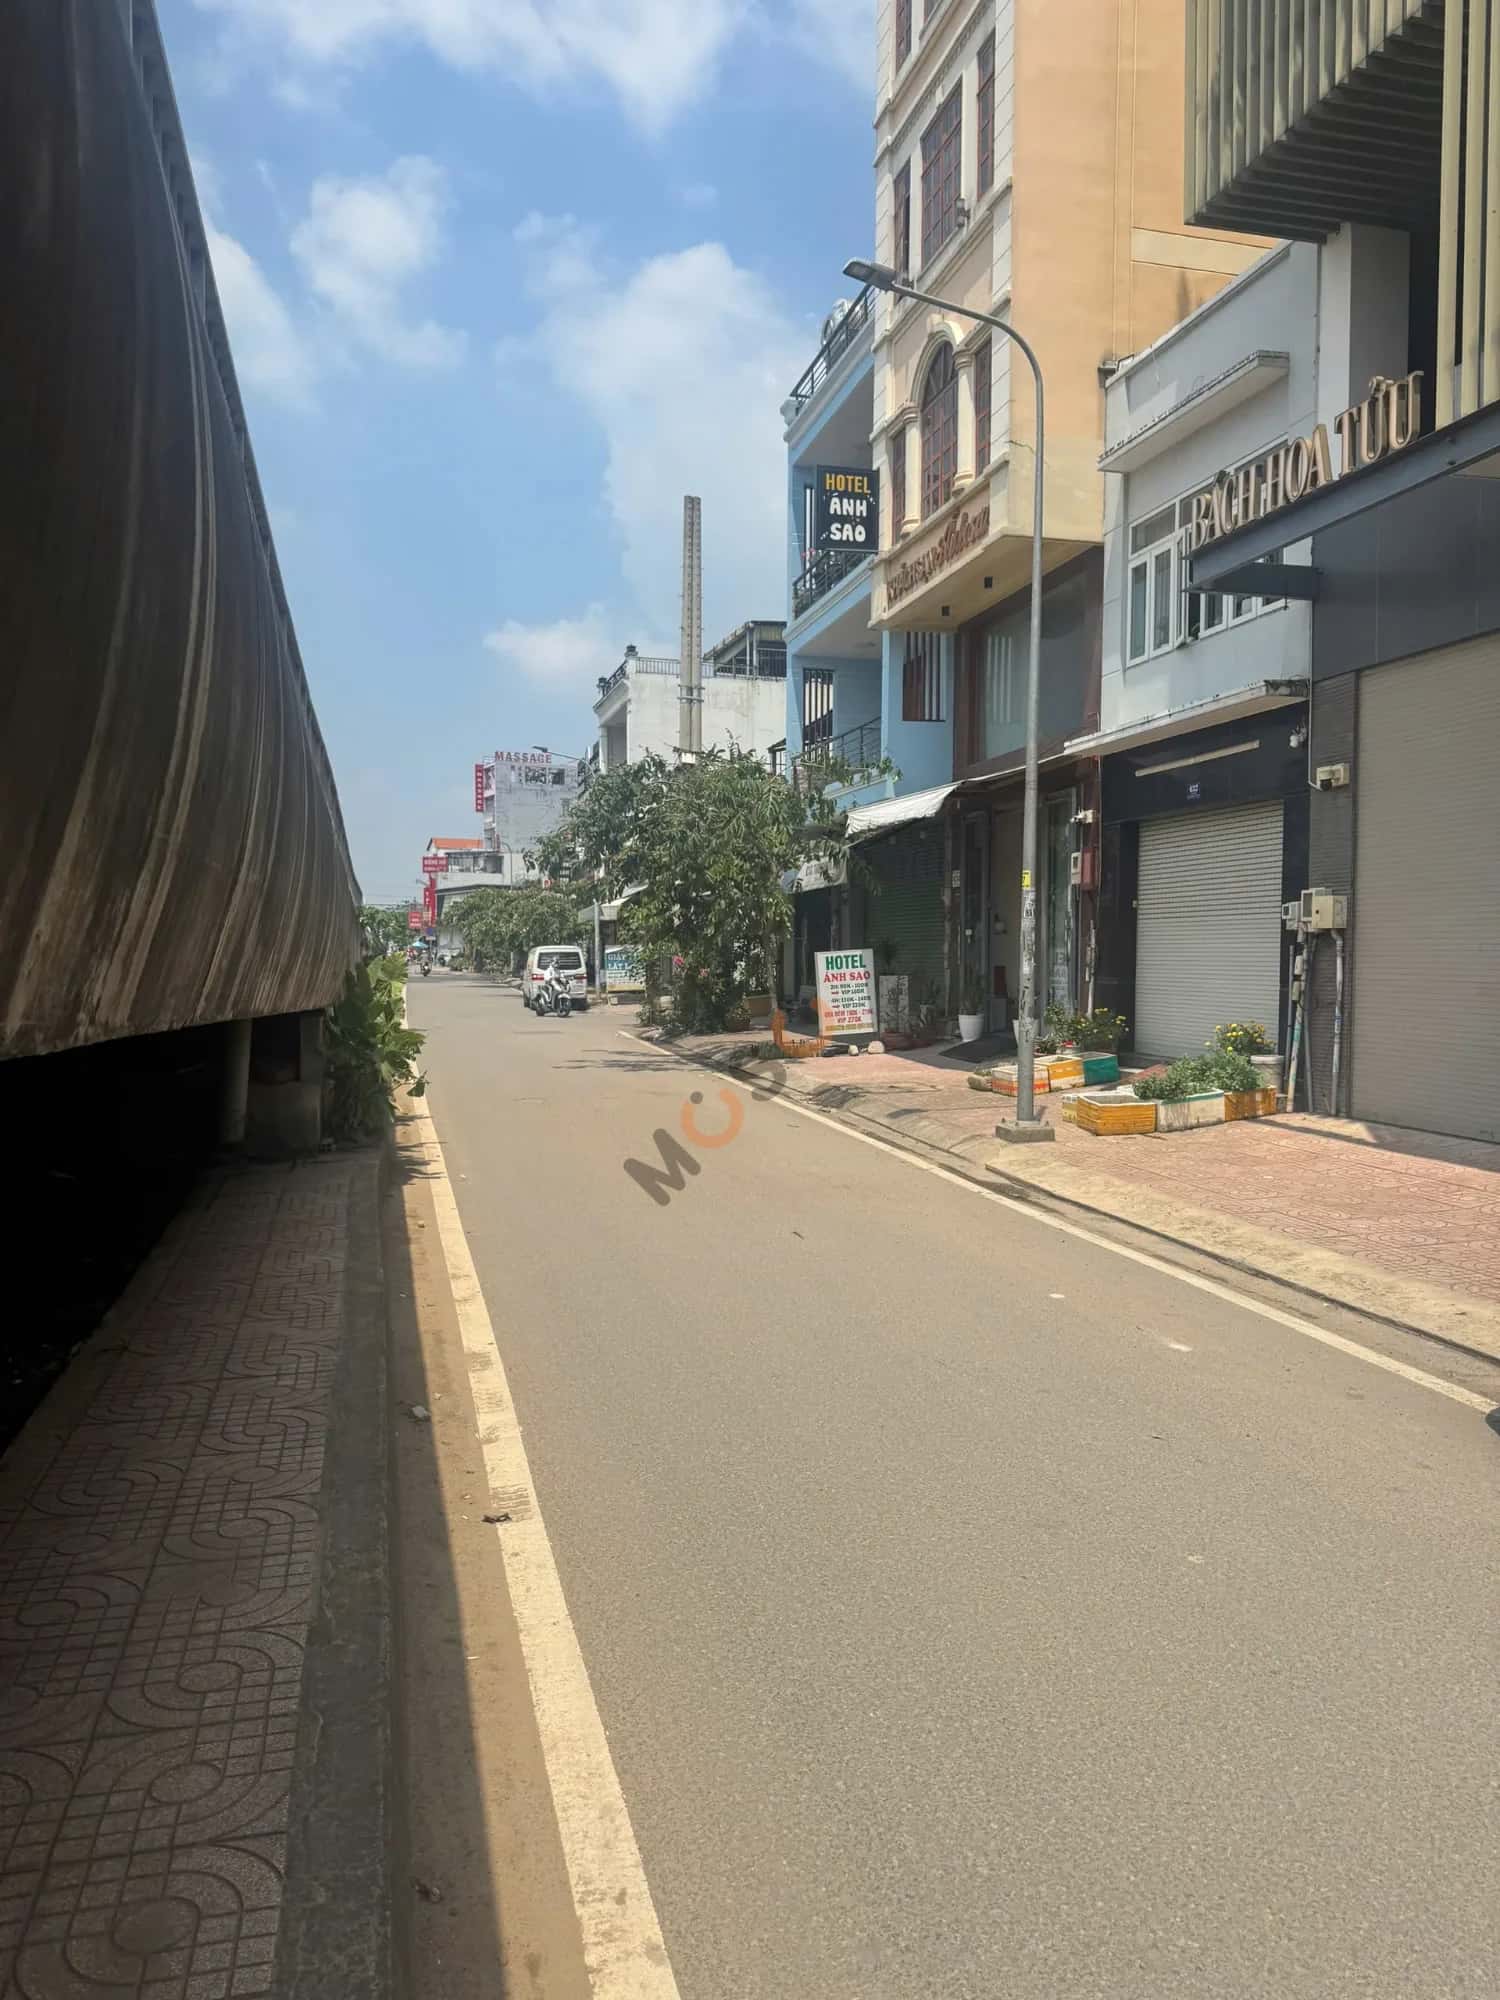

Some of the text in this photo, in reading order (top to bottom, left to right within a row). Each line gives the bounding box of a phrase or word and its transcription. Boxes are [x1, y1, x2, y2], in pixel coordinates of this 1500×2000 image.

[1264, 424, 1335, 514] HOA
[825, 472, 871, 494] HOTEL
[829, 492, 867, 517] ÁNH
[829, 522, 866, 543] SAO
[495, 750, 552, 763] MASSAGE
[826, 955, 867, 970] HOTEL
[823, 971, 871, 983] ÁNH SAO
